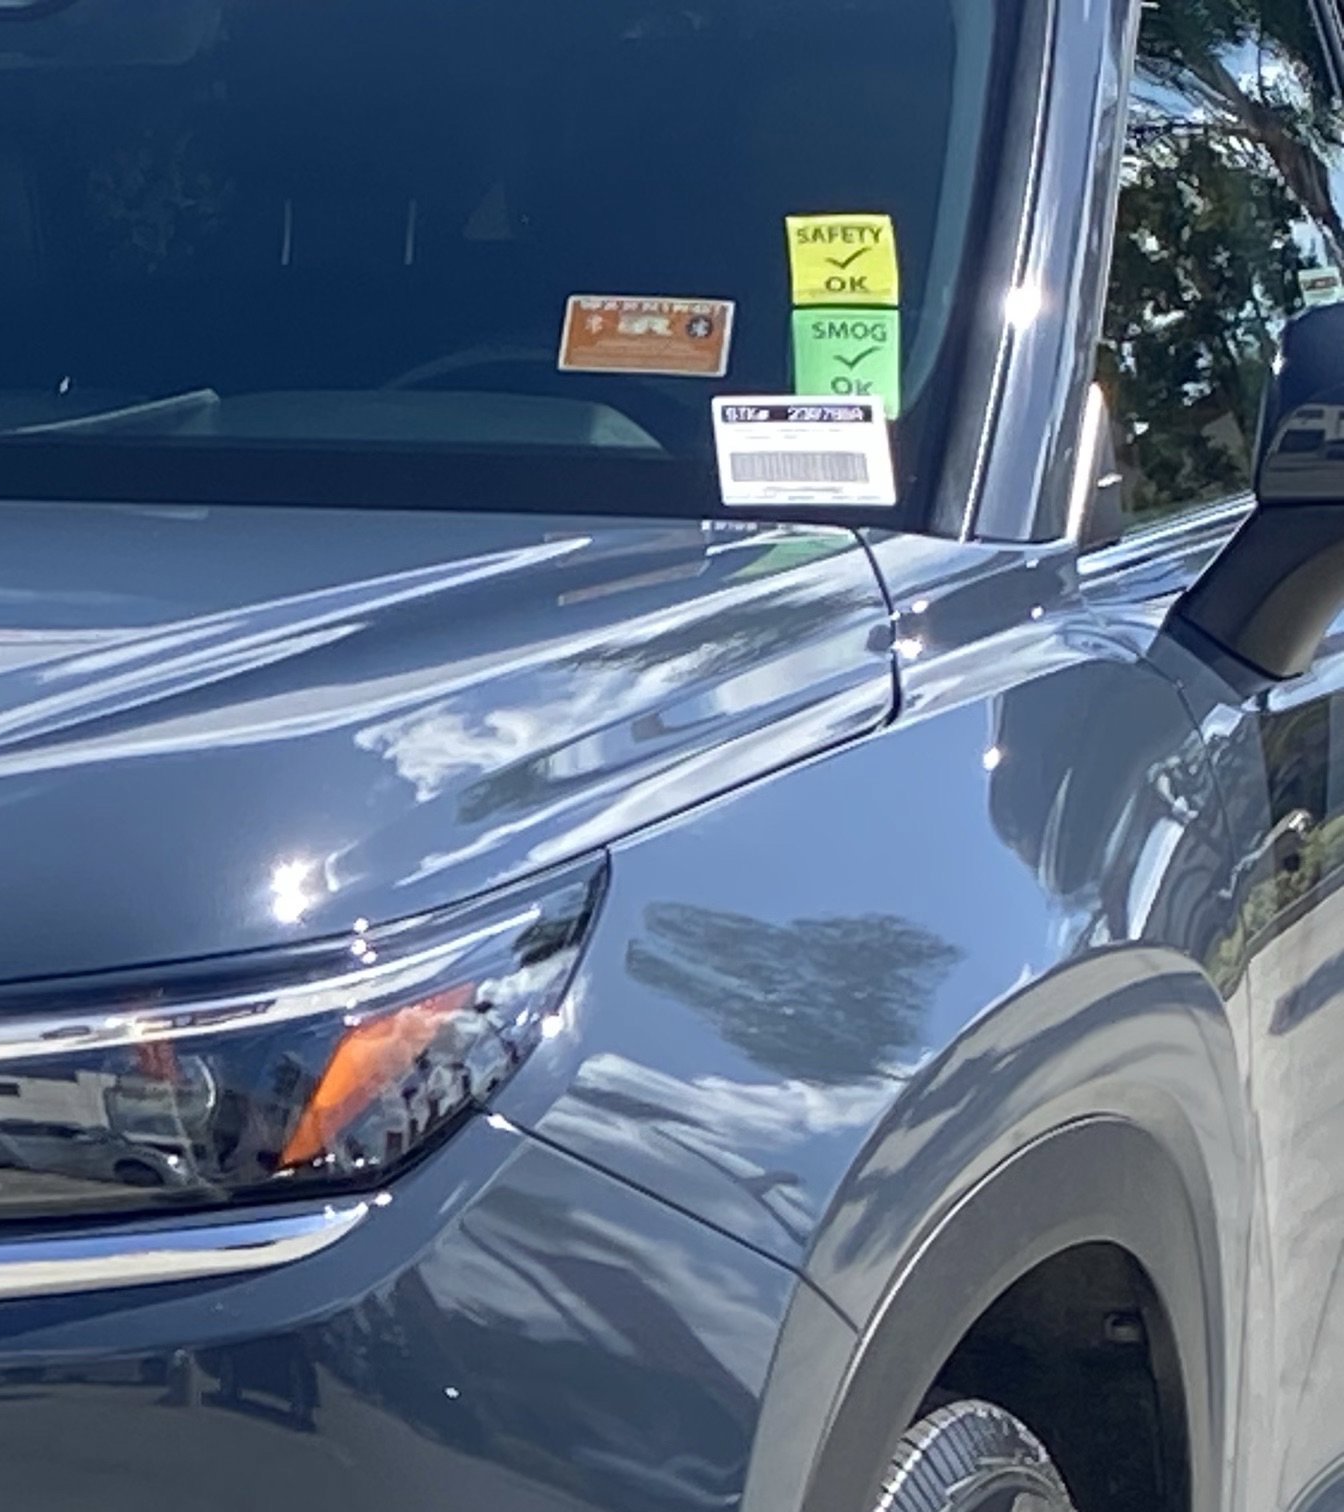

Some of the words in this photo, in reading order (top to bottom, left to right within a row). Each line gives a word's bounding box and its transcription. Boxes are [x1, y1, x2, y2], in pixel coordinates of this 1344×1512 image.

[796, 225, 883, 244] SAFETY
[824, 275, 869, 293] OK
[811, 321, 887, 342] SMOG
[830, 376, 873, 395] OK
